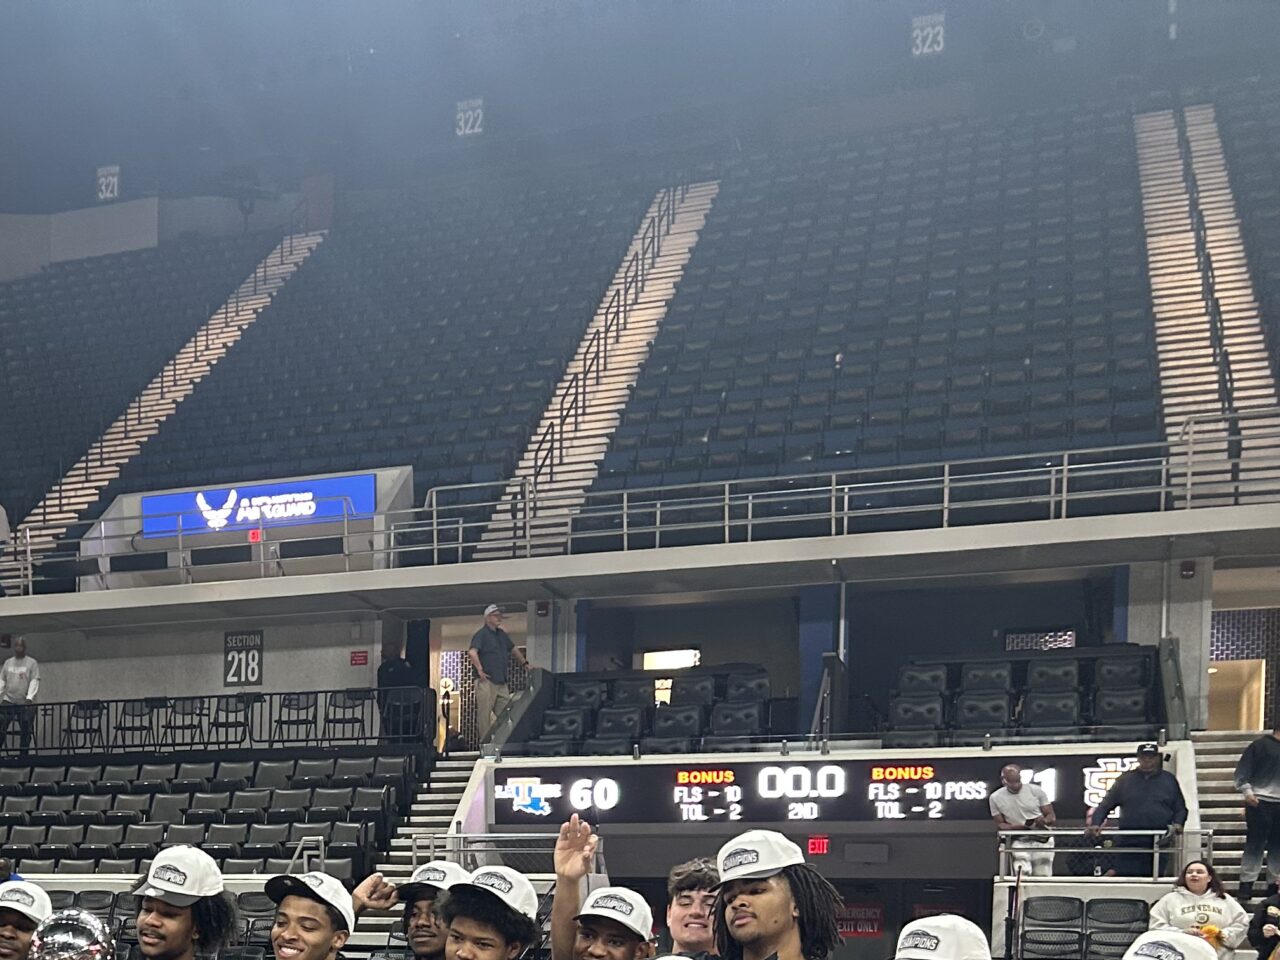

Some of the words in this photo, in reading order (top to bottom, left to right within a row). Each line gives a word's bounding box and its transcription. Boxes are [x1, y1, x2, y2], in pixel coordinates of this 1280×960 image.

[912, 26, 944, 54] 323
[456, 109, 482, 135] 322
[98, 177, 118, 199] 321
[227, 634, 261, 647] SECTION
[227, 650, 259, 682] 218
[677, 770, 736, 784] BONUS
[758, 765, 846, 799] 00.0
[871, 766, 934, 780] BONUS
[569, 778, 619, 810] 60
[673, 786, 703, 803] FLS
[724, 785, 742, 802] 10
[869, 782, 901, 800] FLS
[923, 782, 943, 799] 10
[680, 804, 709, 821] TOL
[729, 803, 742, 821] 2
[788, 802, 819, 820] 2ND
[874, 801, 904, 819] TOL
[928, 800, 942, 819] 2
[807, 836, 829, 855] EXIT
[723, 850, 759, 870] CHAMPIONS
[154, 868, 187, 886] CHAMPIONS
[473, 873, 513, 893] CHAMPIONS
[592, 896, 633, 915] CHAMPIONS
[1180, 904, 1224, 917] KENNESAW
[837, 921, 858, 934] EXIT
[860, 921, 881, 933] ONLY
[898, 934, 940, 950] CHAMPIONS
